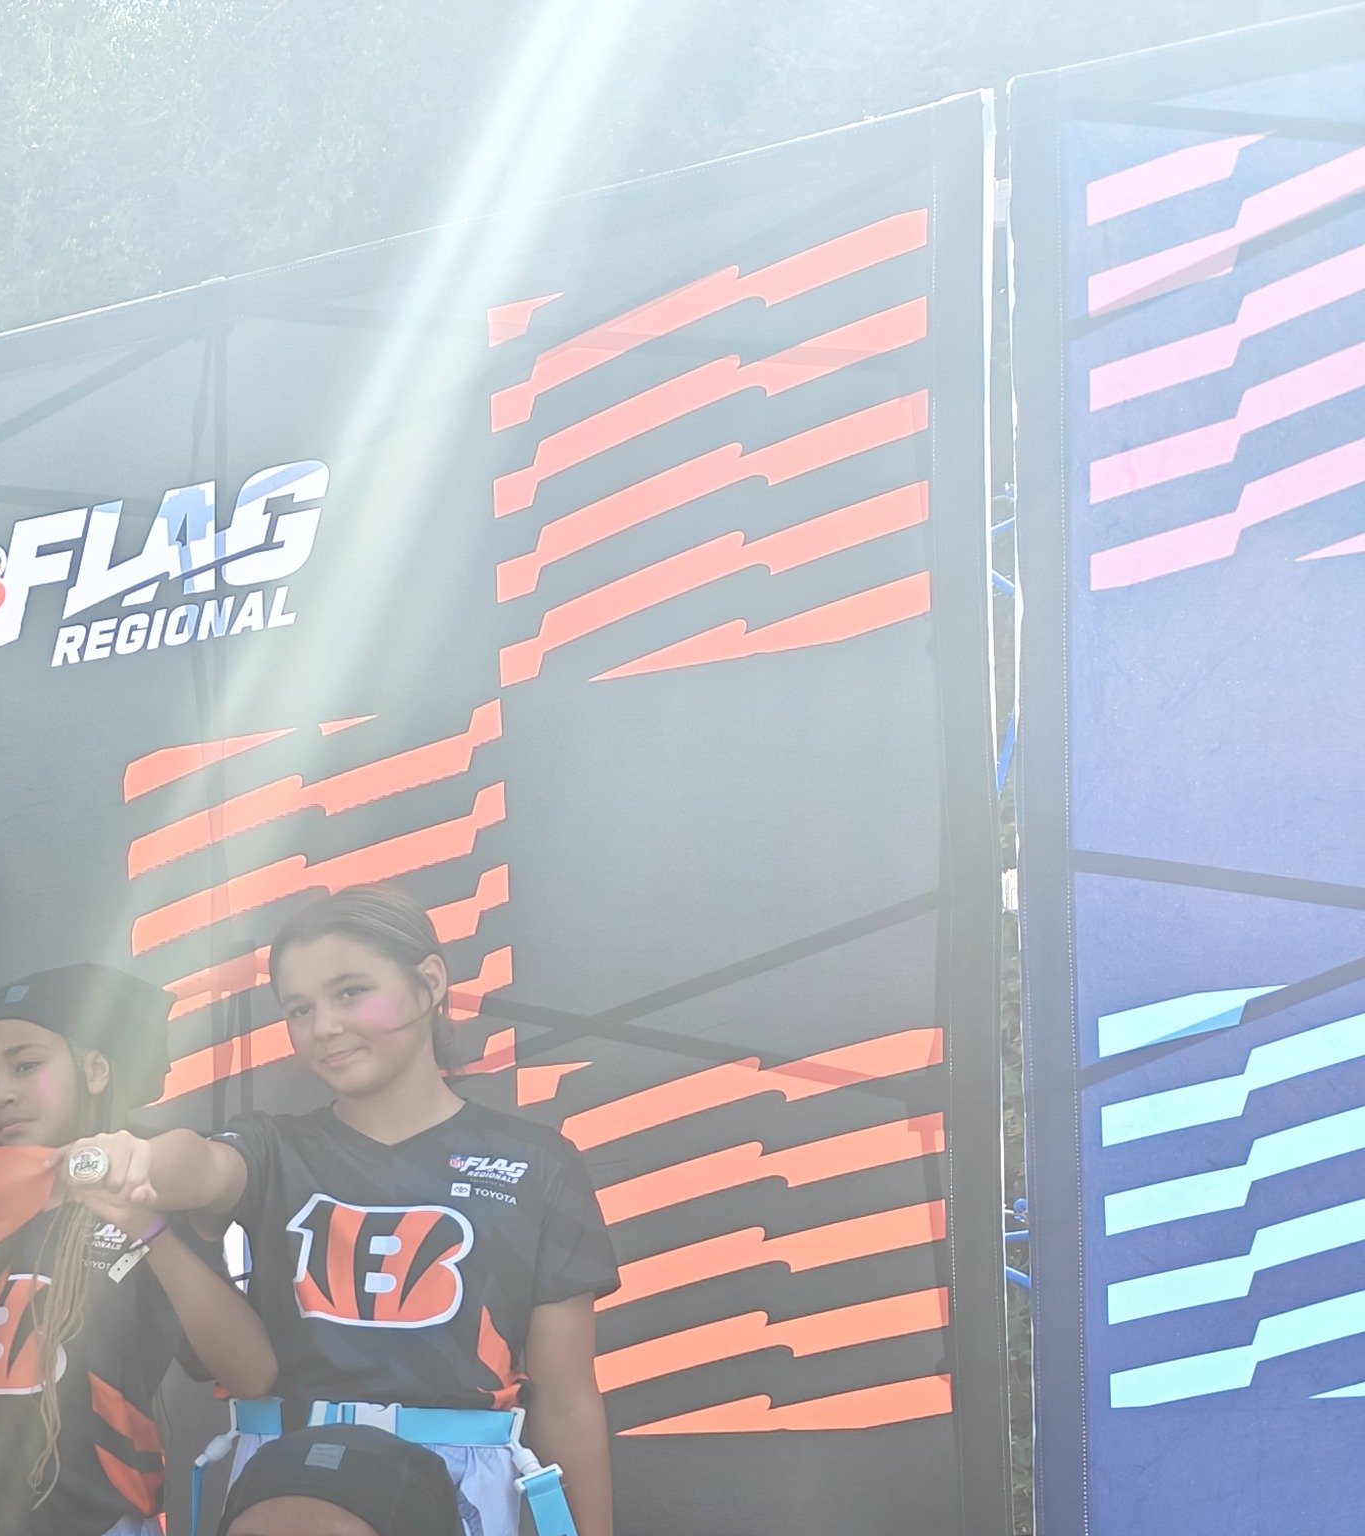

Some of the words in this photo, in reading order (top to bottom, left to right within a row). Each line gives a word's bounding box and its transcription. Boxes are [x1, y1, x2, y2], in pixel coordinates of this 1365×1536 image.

[51, 585, 297, 667] REGIONAL
[459, 1156, 529, 1178] FLAG
[467, 1170, 519, 1184] REGIONALS
[474, 1187, 517, 1205] TOYOTA
